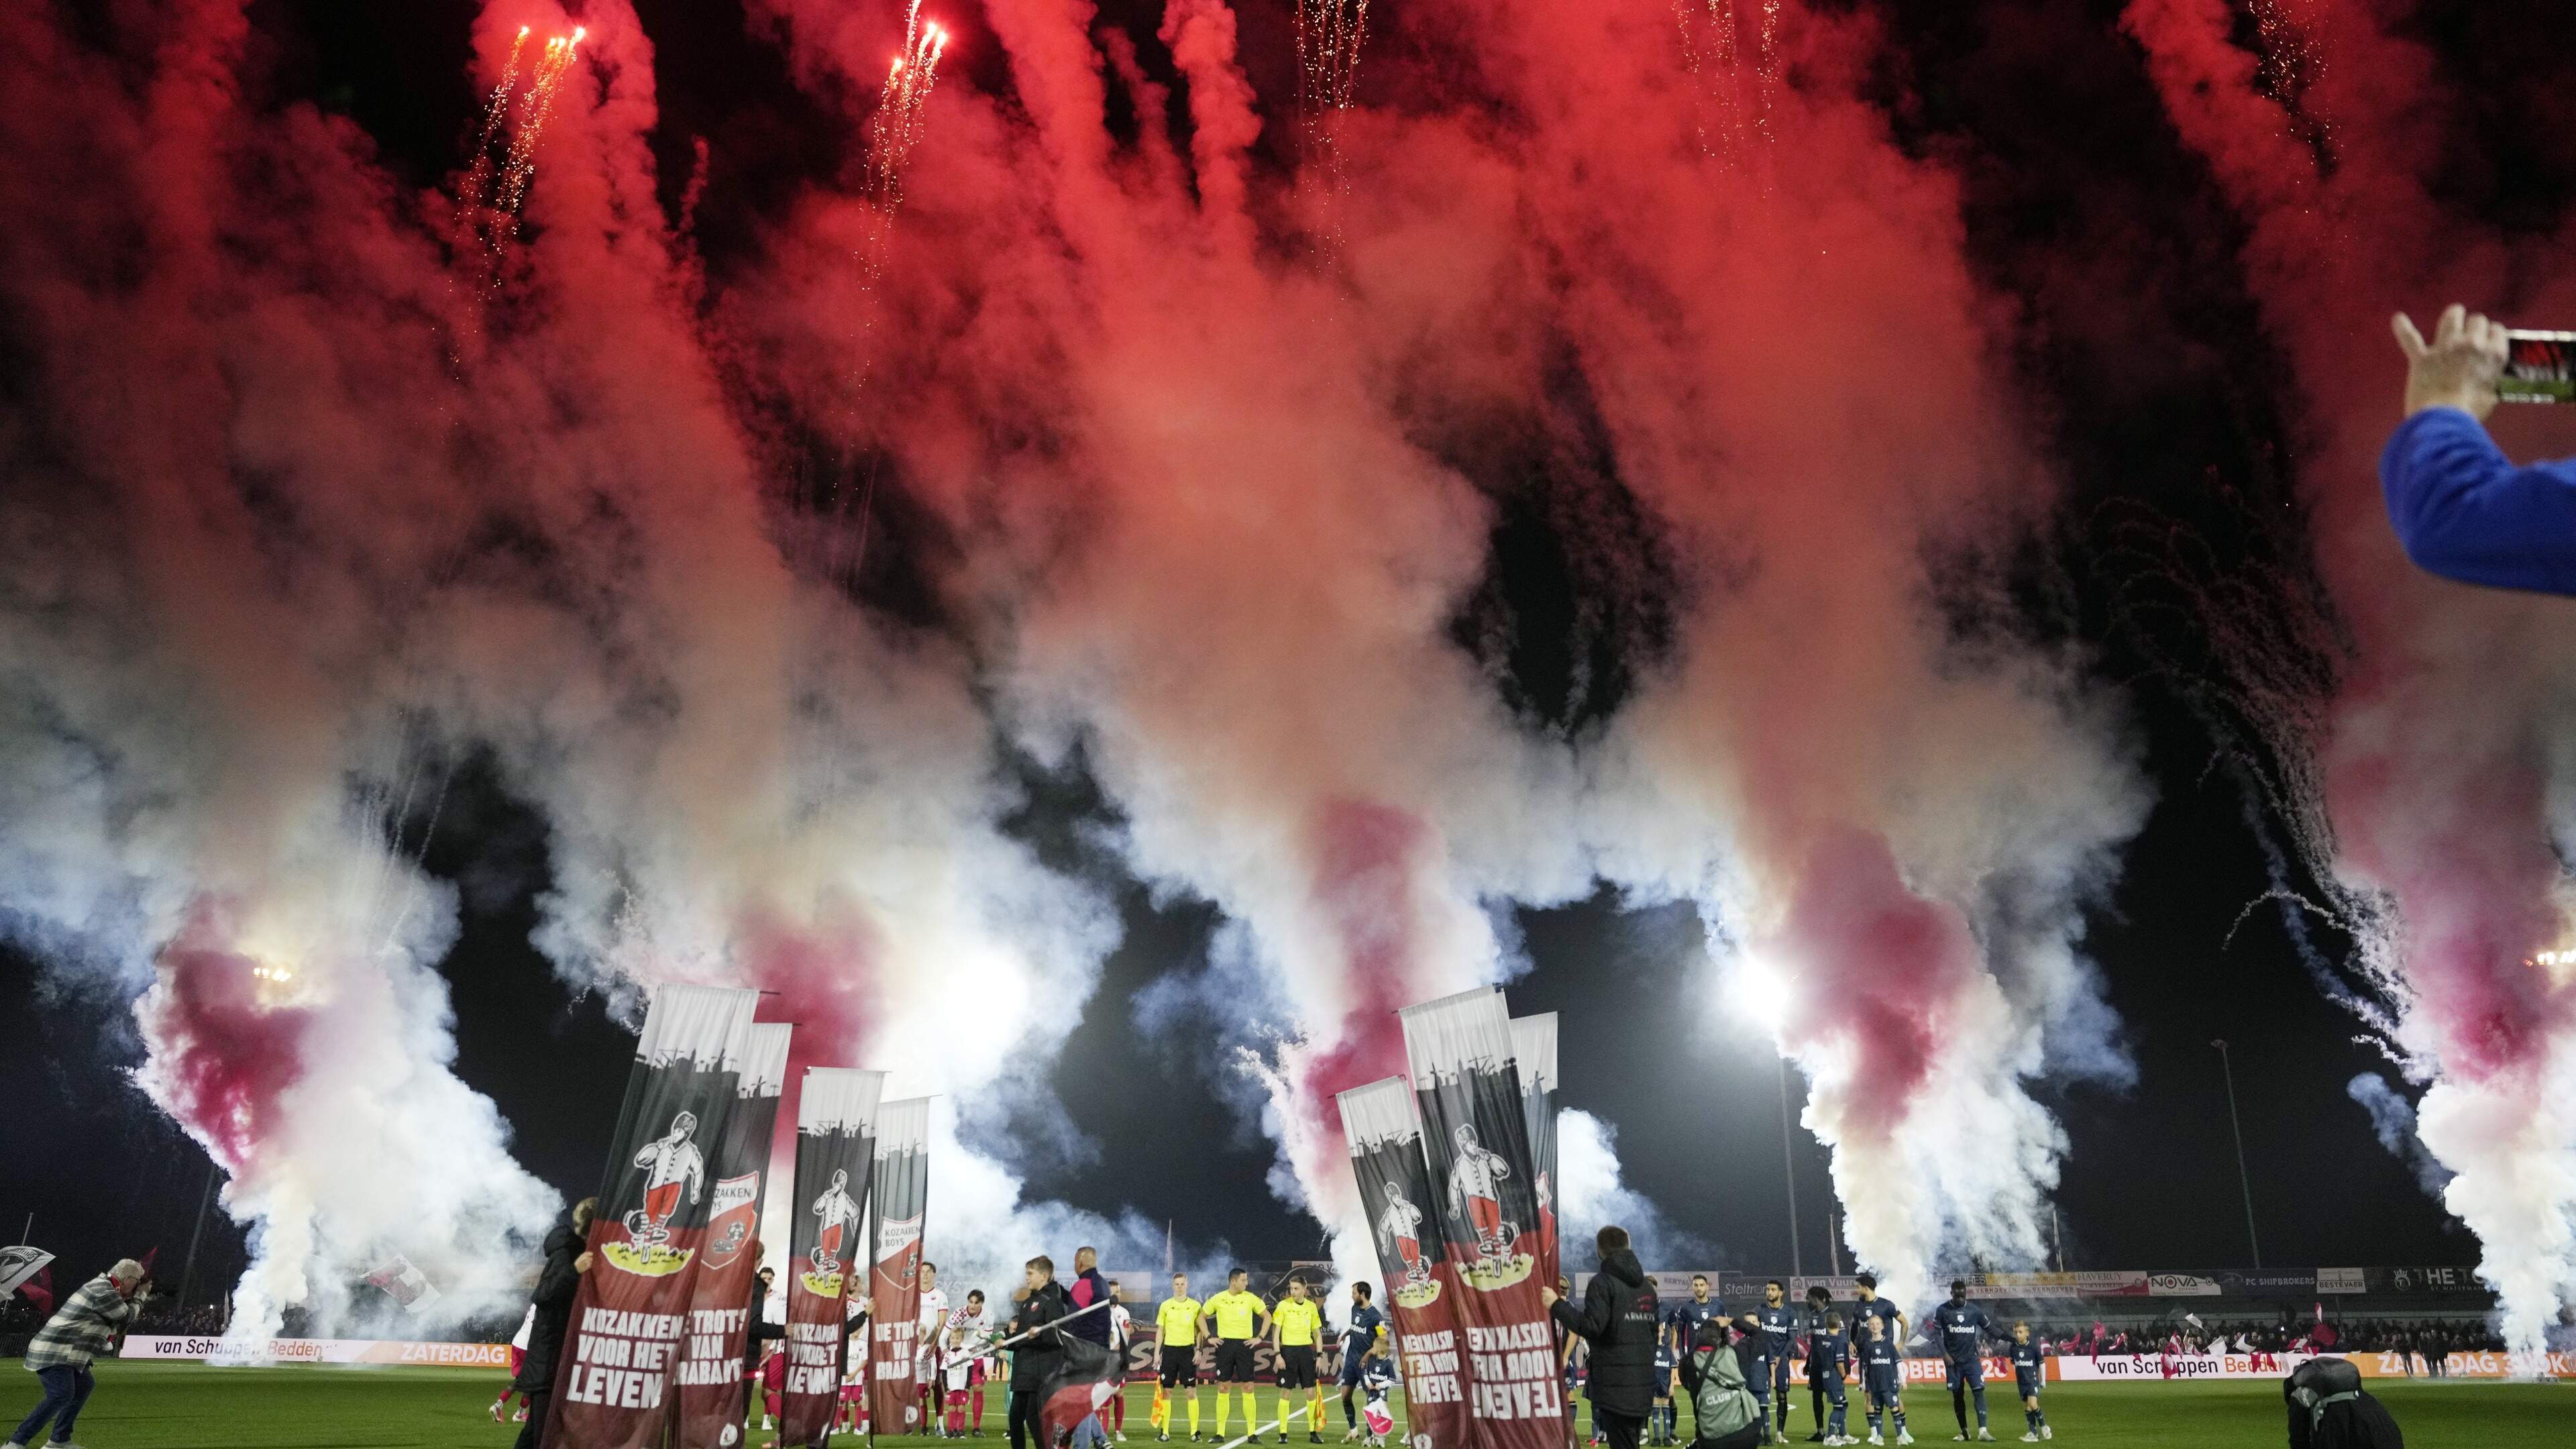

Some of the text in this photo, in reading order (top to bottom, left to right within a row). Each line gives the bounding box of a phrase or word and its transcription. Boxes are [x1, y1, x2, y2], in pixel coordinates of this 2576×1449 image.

[885, 1238, 905, 1246] BOYS
[1807, 1279, 1826, 1287] van
[2151, 1275, 2198, 1289] NOVA
[2246, 1277, 2316, 1286] PC SHIPBROKERS
[2414, 1268, 2455, 1285] THE
[581, 1306, 684, 1340] KOZAKKEN
[1761, 1322, 1787, 1334] indeed
[1948, 1324, 1975, 1334] indeed
[155, 1342, 182, 1354] van
[268, 1341, 323, 1357] Bedden
[400, 1344, 505, 1364] ZATERDAG
[577, 1334, 631, 1368] VOOR
[691, 1334, 724, 1359] VAN
[1654, 1359, 1670, 1368] deed
[1870, 1356, 1890, 1365] indeed
[2097, 1362, 2129, 1374] van
[2133, 1358, 2218, 1377] Schppen
[673, 1357, 743, 1385] RABANT
